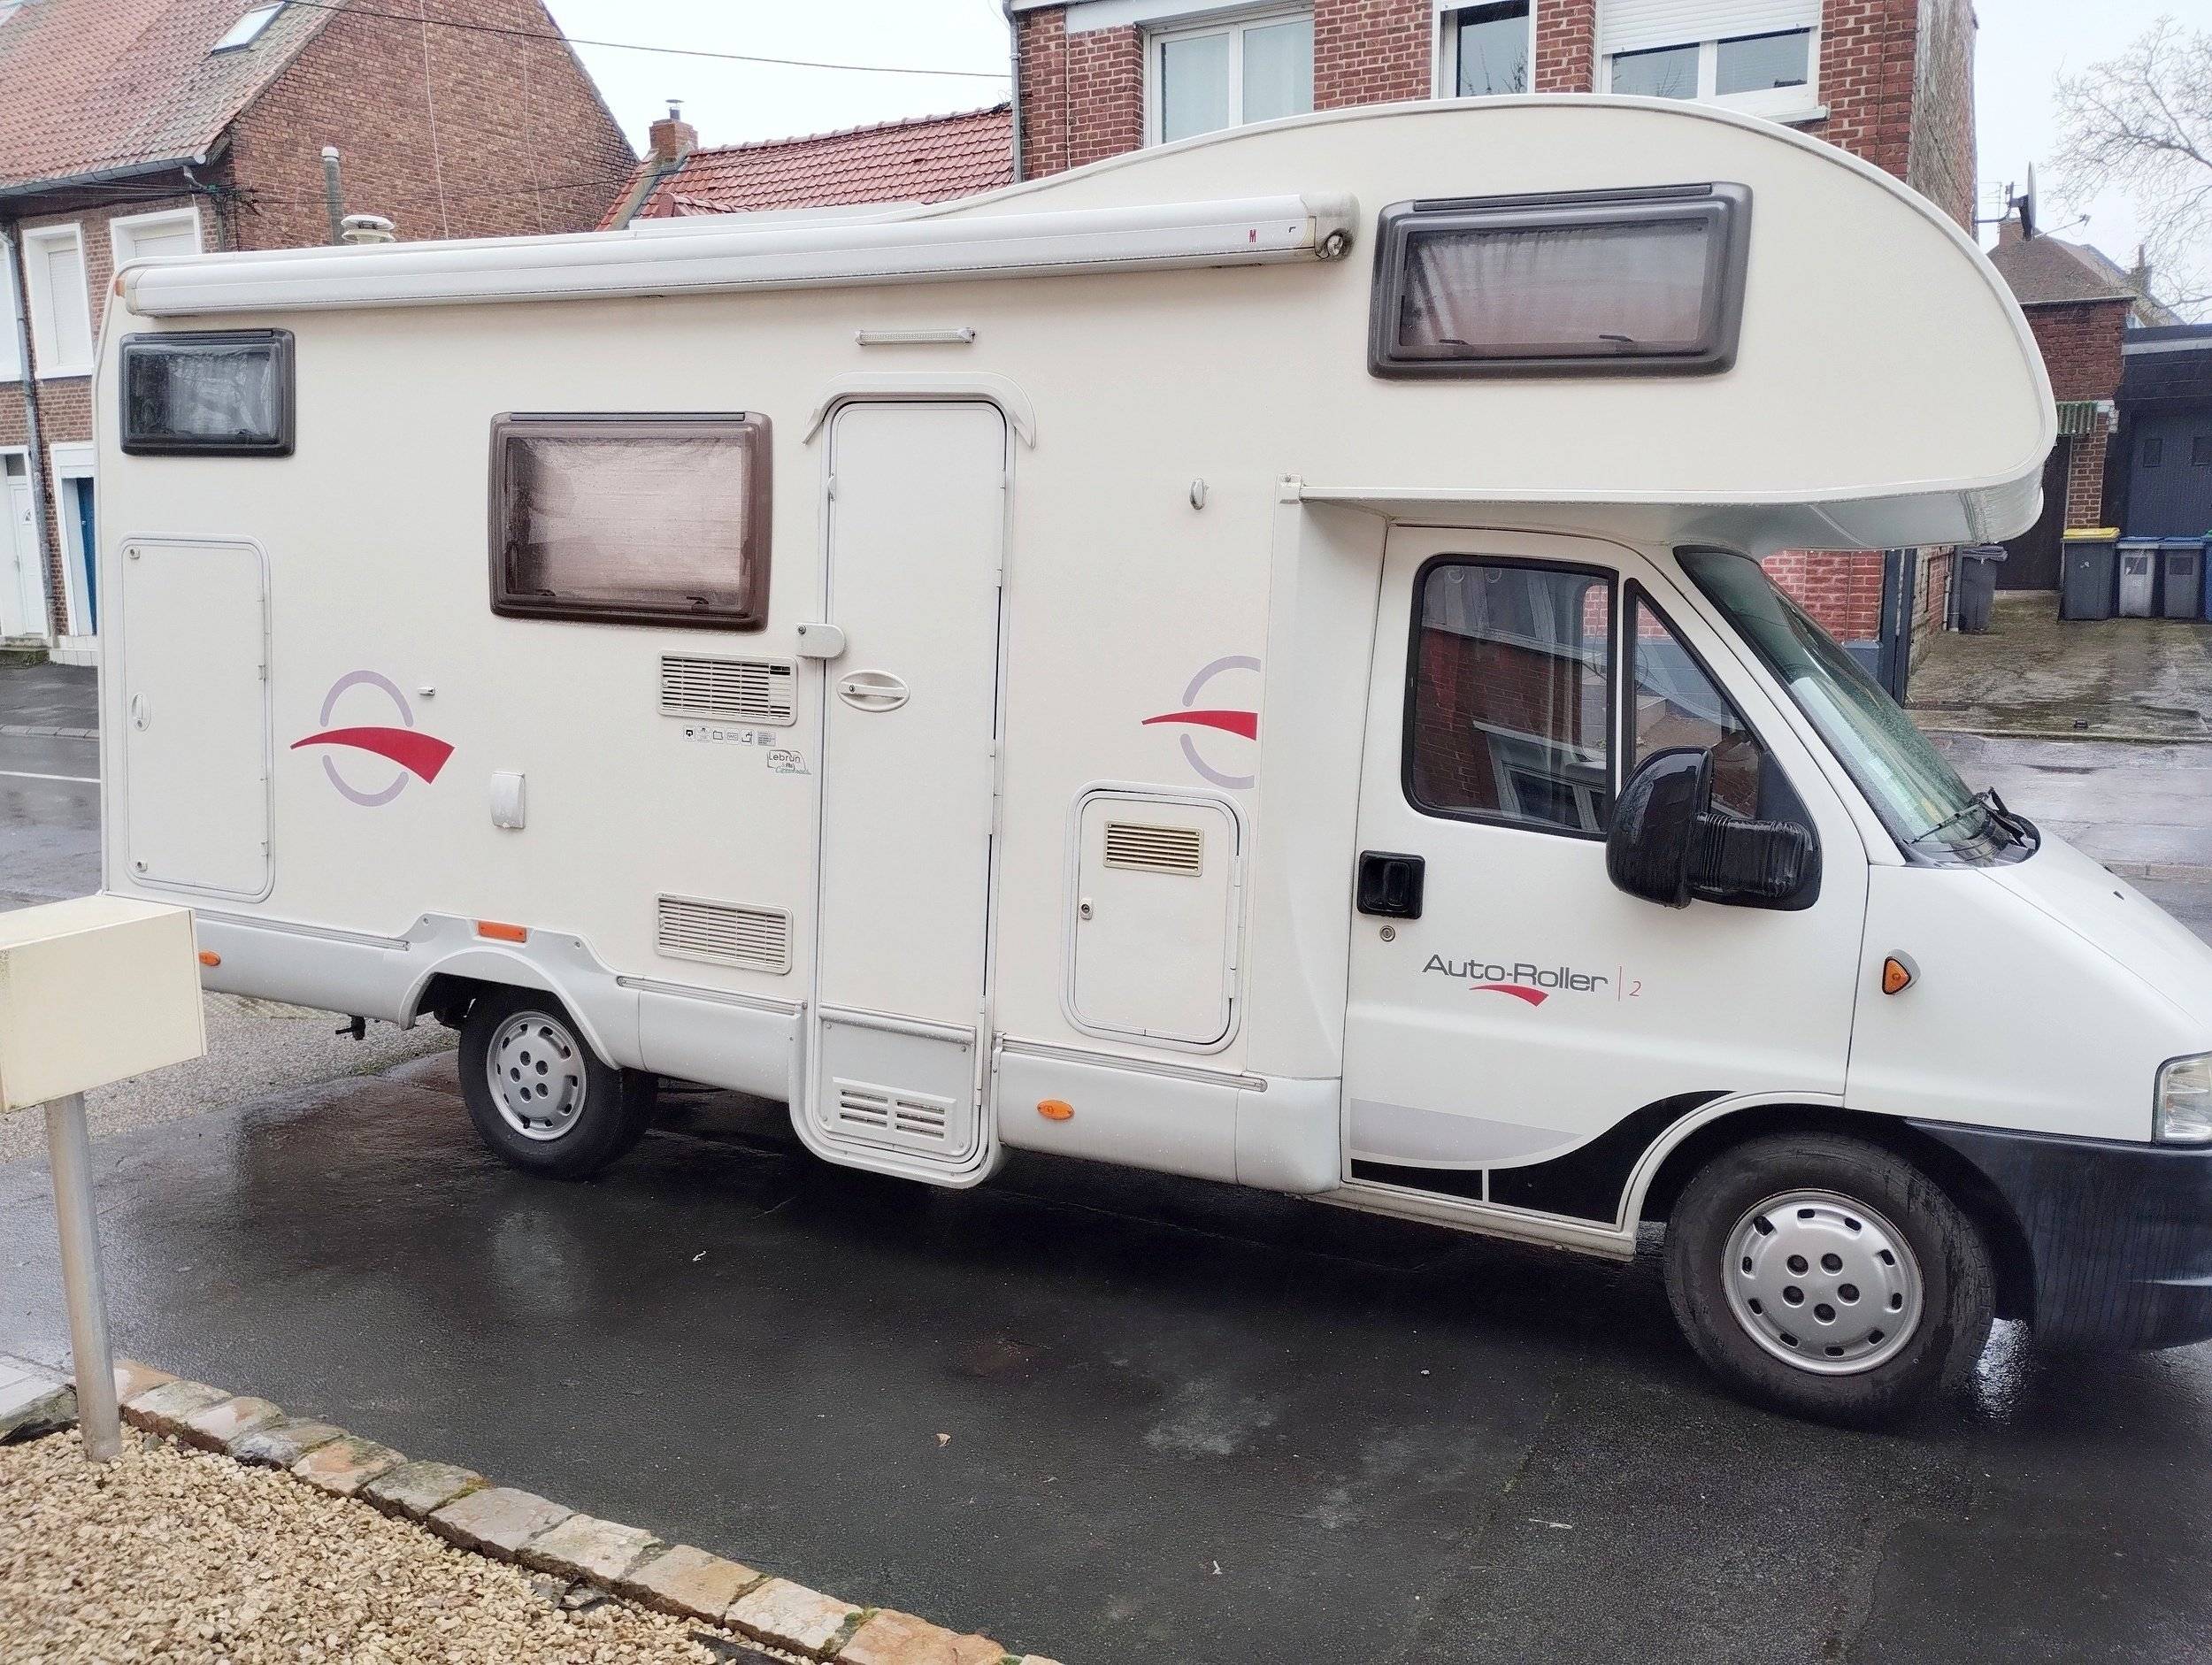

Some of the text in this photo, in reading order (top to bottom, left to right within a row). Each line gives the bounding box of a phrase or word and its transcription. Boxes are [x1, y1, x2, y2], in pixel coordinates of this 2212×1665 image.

[769, 752, 801, 763] Lebrun
[1421, 954, 1642, 998] Auto-Roller 2
